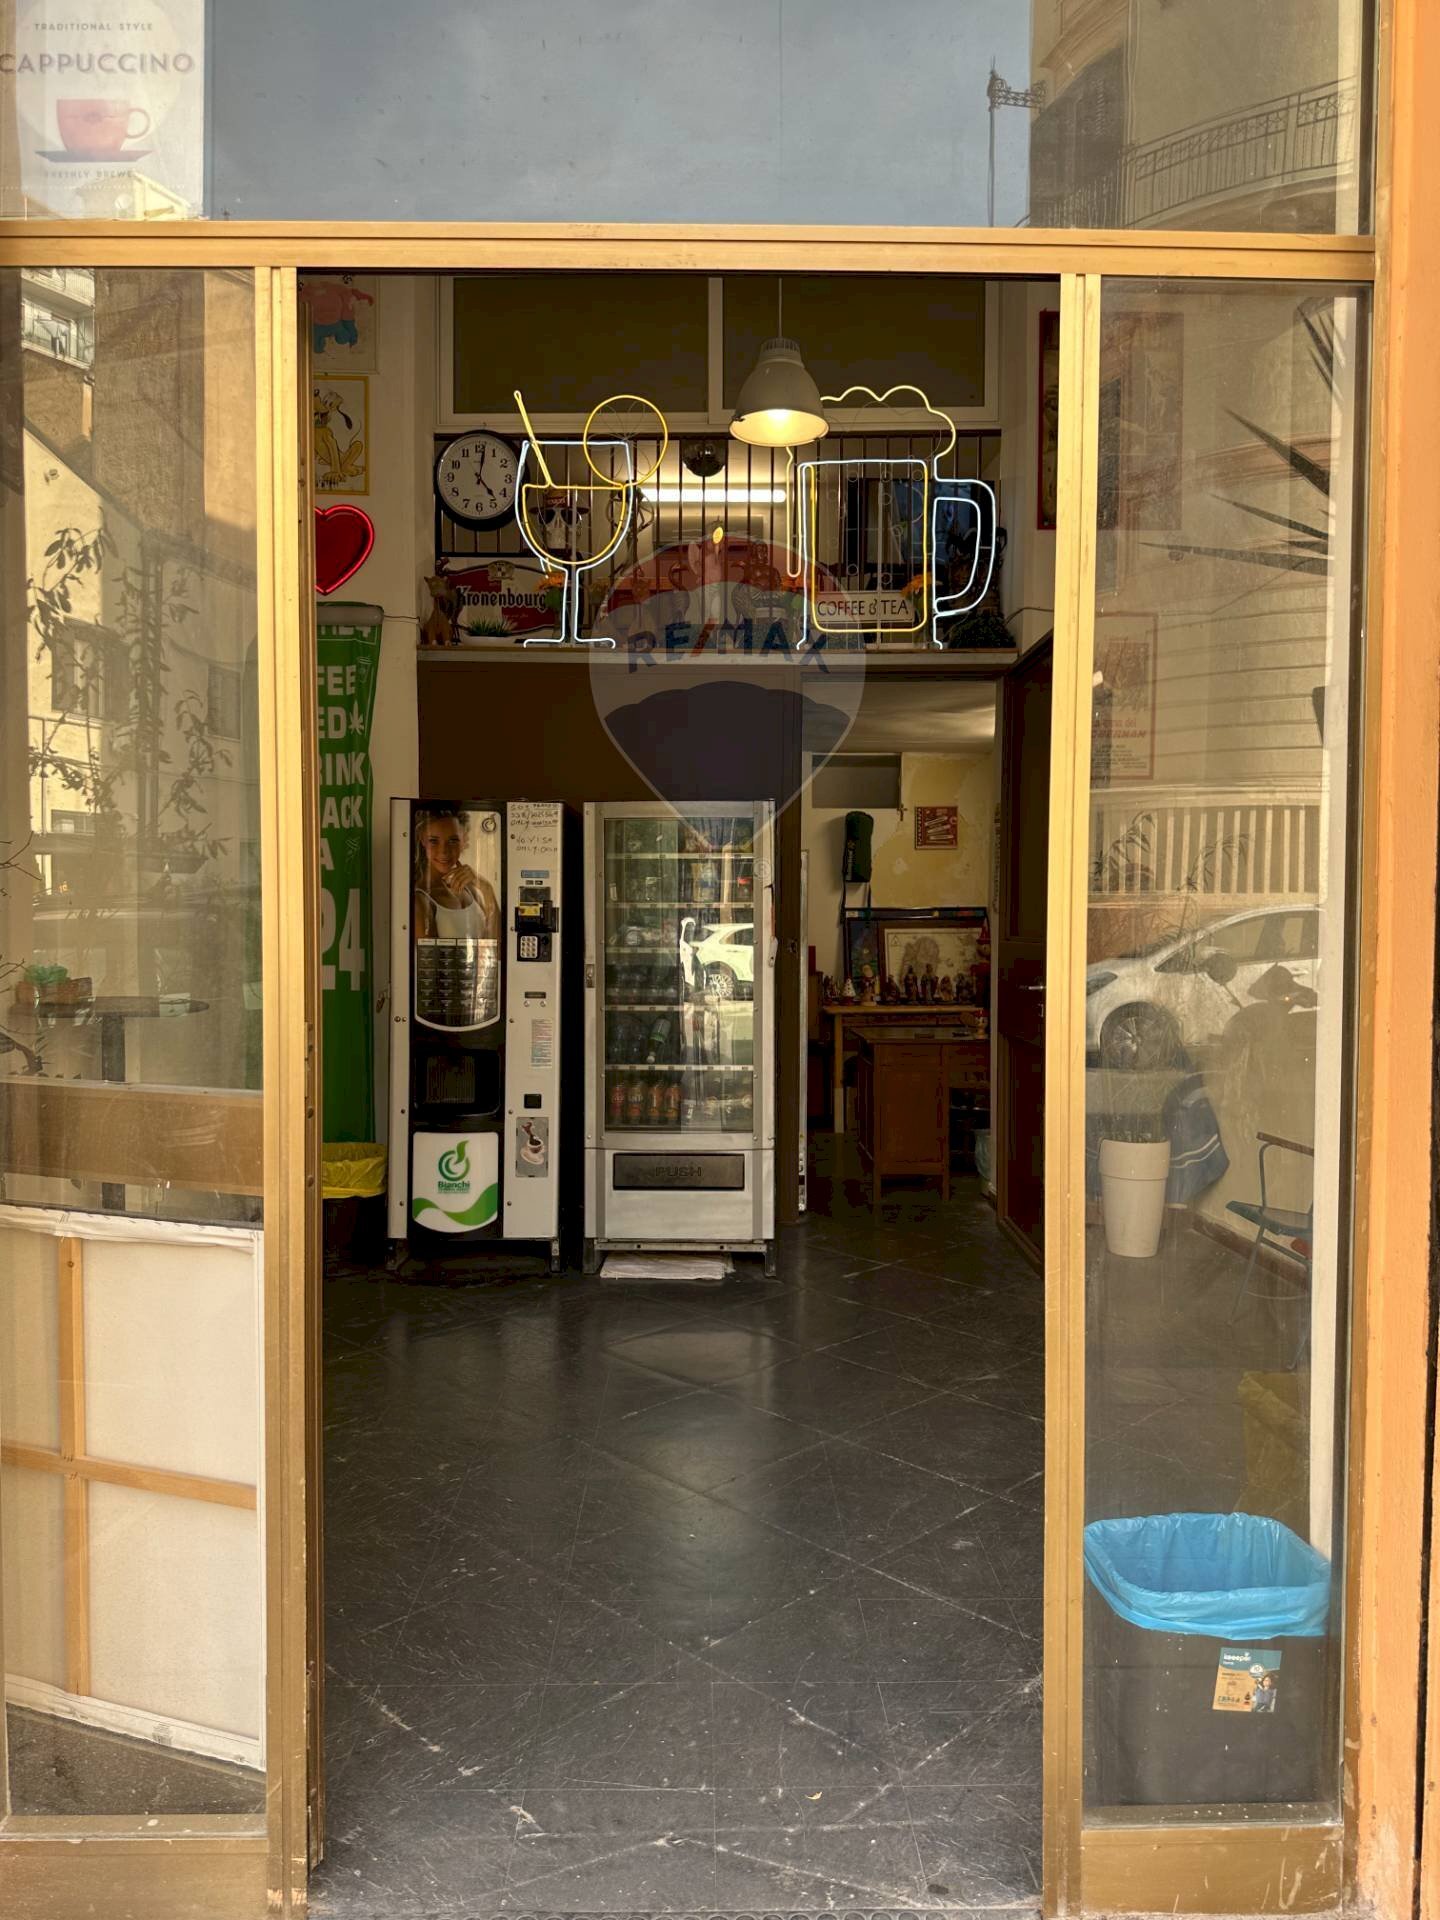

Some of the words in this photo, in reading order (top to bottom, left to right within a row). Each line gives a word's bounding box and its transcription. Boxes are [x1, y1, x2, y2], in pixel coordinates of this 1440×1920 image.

[34, 23, 112, 31] TRADITIONAL
[119, 23, 153, 31] STYLE
[0, 53, 194, 73] CAPPUCCINO
[456, 585, 548, 613] Kronenbourg
[817, 600, 865, 616] COFFEE
[880, 600, 909, 615] TEA
[655, 1166, 702, 1177] PUSH
[438, 1180, 470, 1188] Bianchi
